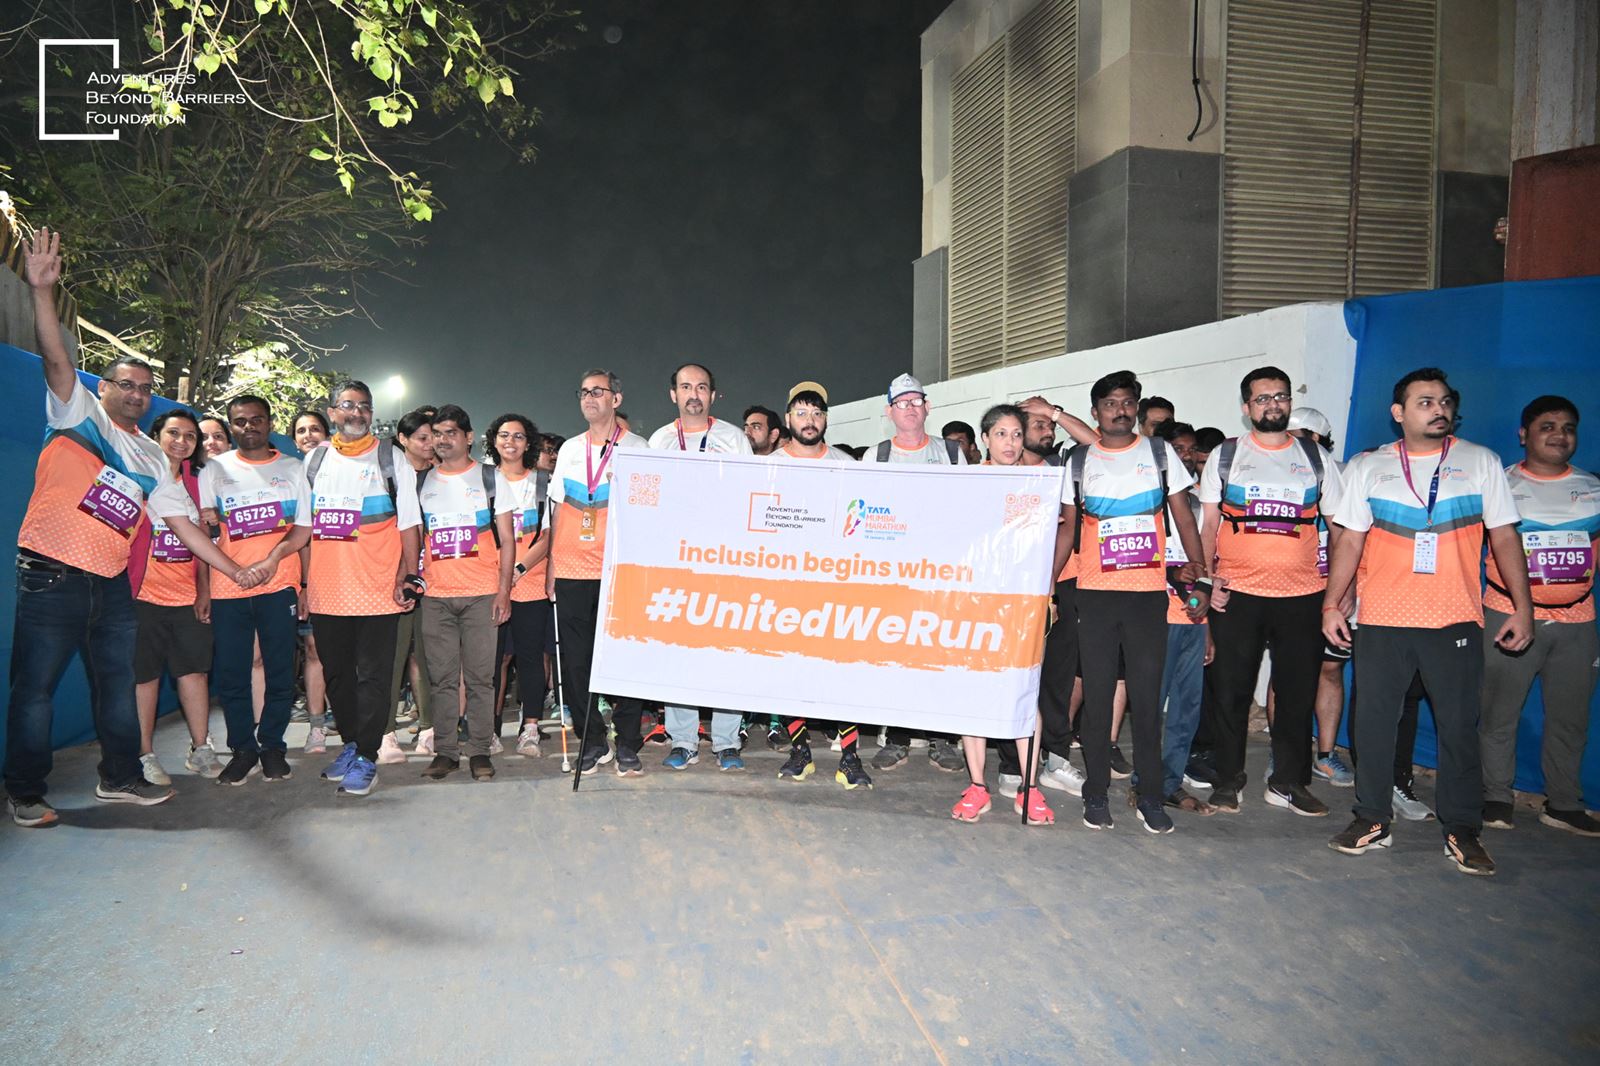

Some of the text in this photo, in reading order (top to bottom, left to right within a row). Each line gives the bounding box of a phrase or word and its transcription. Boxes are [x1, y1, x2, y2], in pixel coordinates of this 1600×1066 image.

[100, 489, 138, 519] 65627
[867, 506, 891, 514] TATA
[1254, 503, 1296, 518] 65793
[235, 505, 276, 523] 65725
[319, 512, 354, 525] 65613
[866, 514, 896, 522] MUMBAI
[866, 522, 908, 531] MARATHON
[435, 529, 471, 543] 65788
[1109, 536, 1152, 552] 65624
[679, 540, 973, 583] inclusion begins when
[1537, 551, 1585, 566] 65795
[645, 586, 1004, 652] #UnitedWeRun
